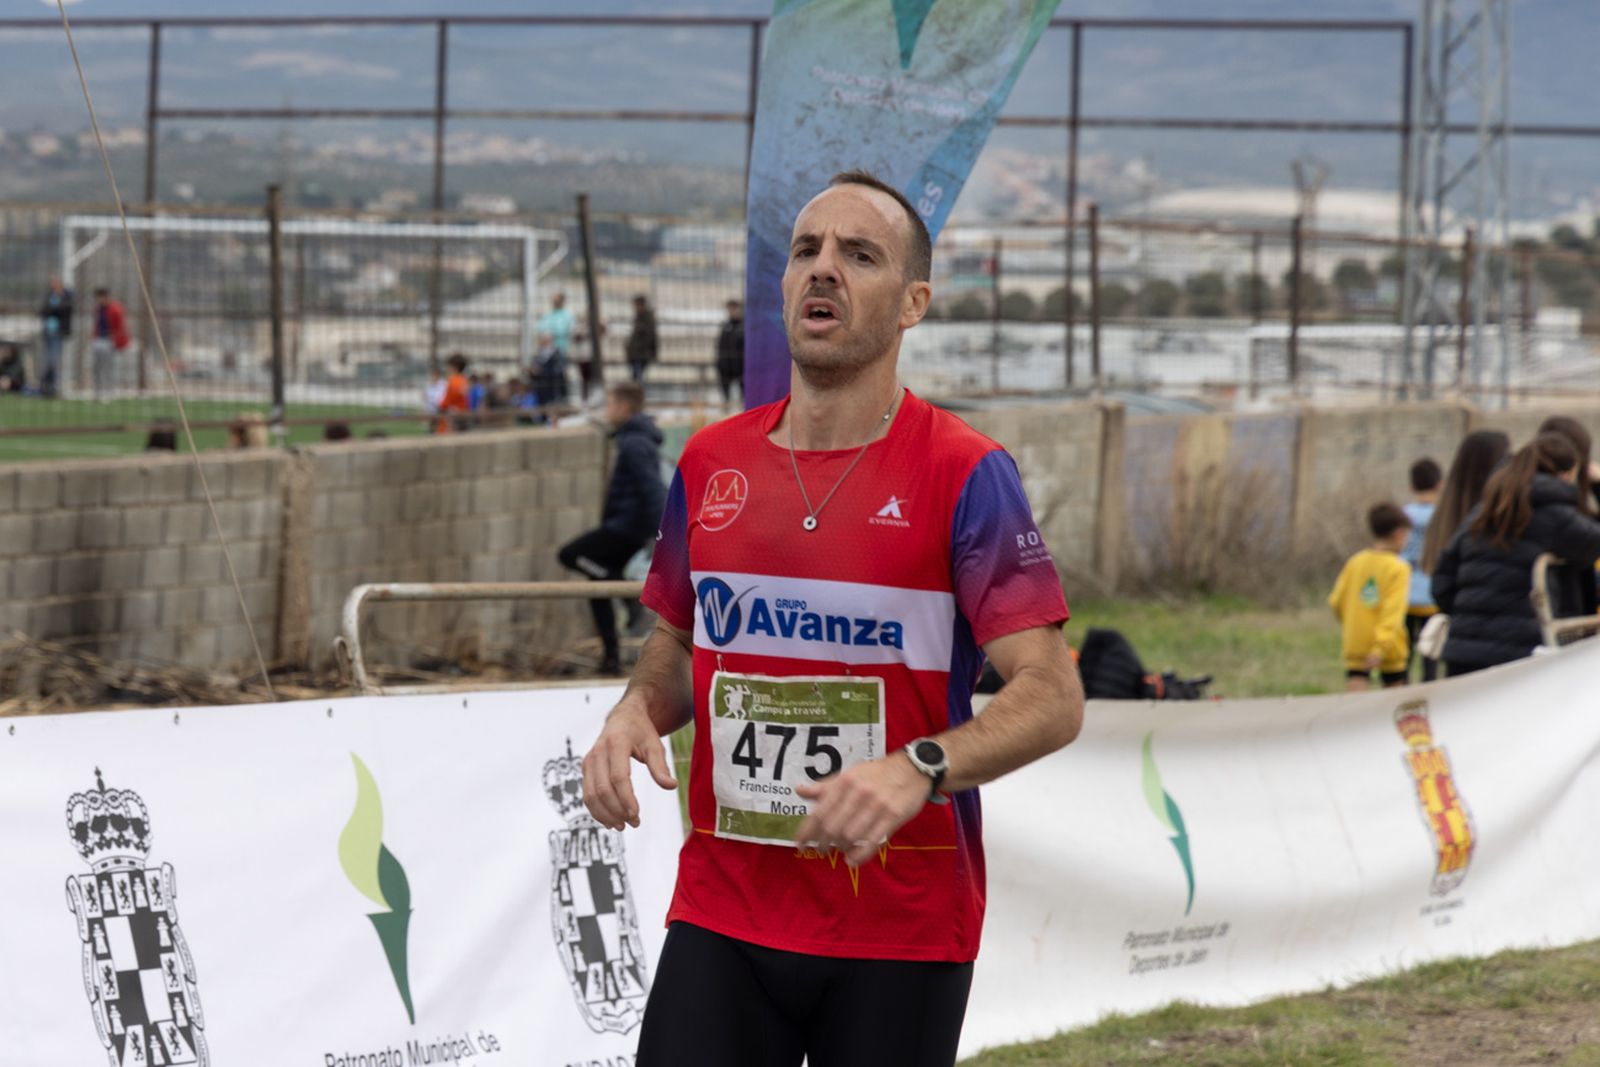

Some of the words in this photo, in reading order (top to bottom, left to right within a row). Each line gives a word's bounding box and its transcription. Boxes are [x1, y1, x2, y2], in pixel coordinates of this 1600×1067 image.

[775, 598, 807, 611] GRUPO
[746, 598, 904, 650] Avanza
[731, 721, 843, 781] 475
[739, 780, 792, 796] Francisco
[770, 801, 807, 816] Mora
[324, 1045, 403, 1067] Patronato
[406, 1031, 478, 1067] Municipal
[476, 1030, 501, 1053] de
